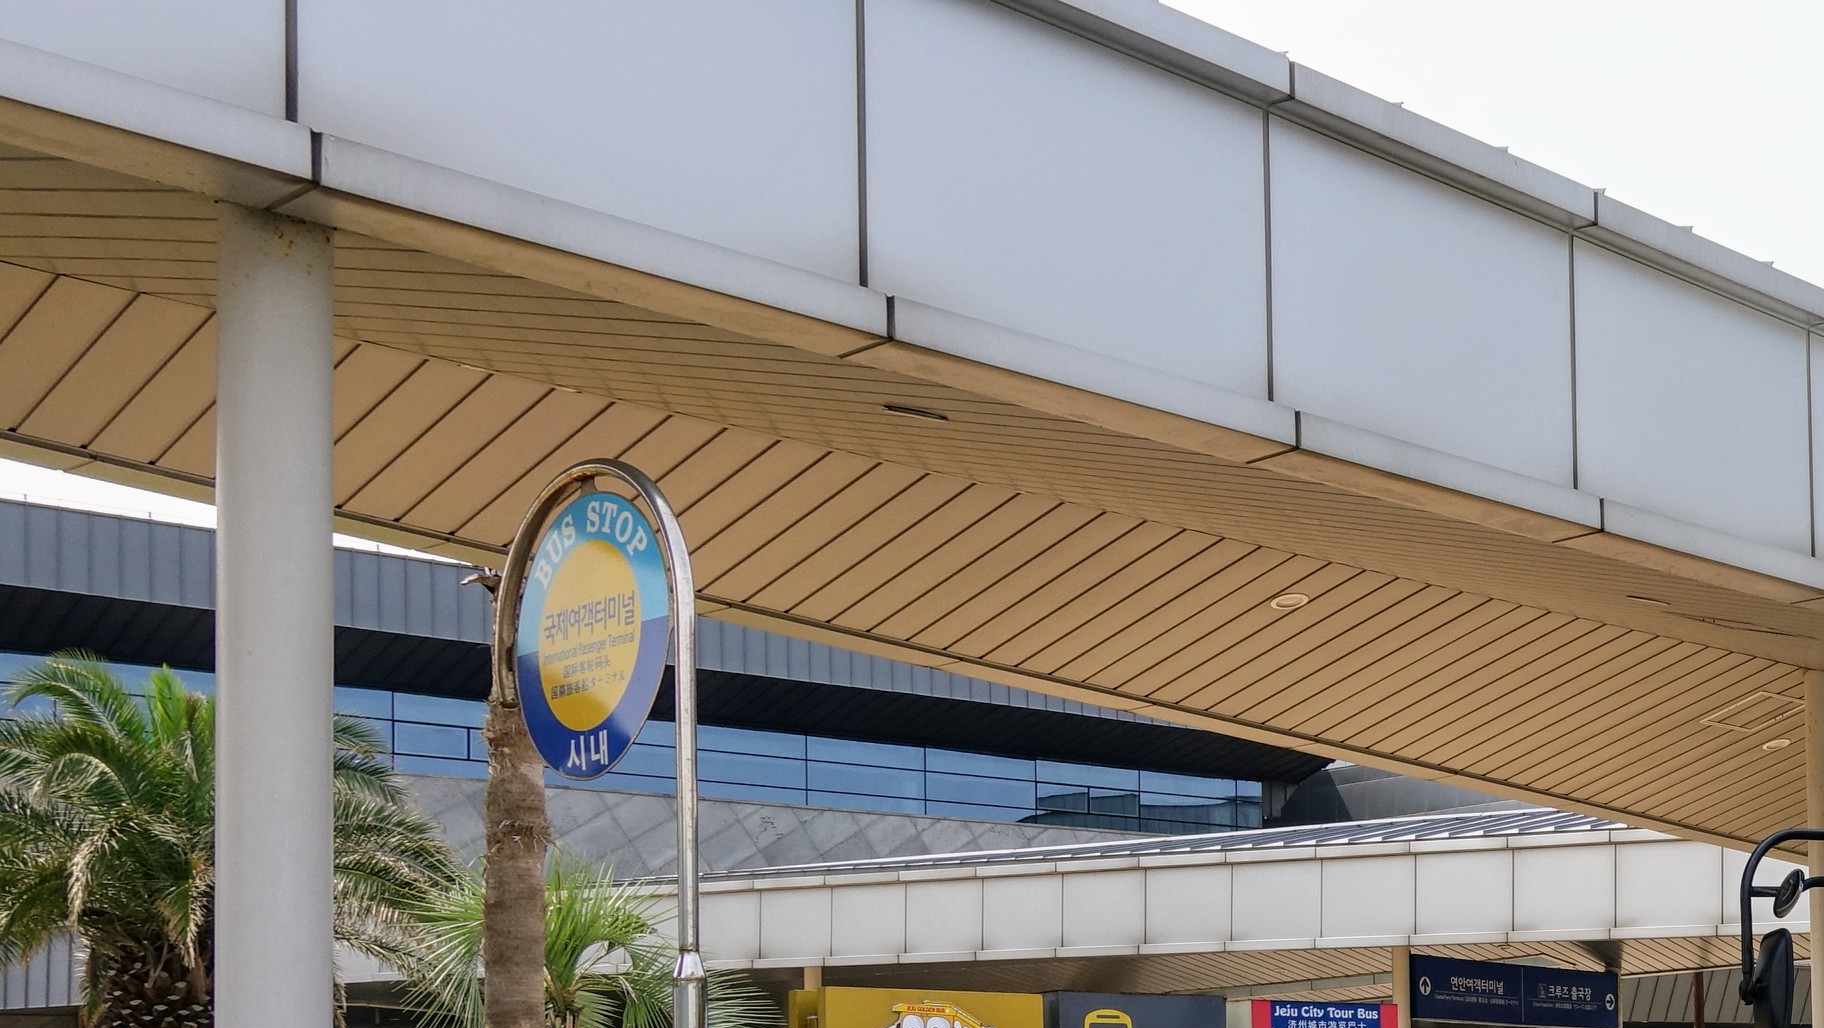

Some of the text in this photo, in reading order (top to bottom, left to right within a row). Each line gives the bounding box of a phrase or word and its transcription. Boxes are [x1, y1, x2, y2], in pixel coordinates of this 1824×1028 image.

[534, 500, 649, 592] BUS STOP
[543, 589, 635, 646] 국제여객터미널
[566, 729, 609, 771] 시내
[1450, 976, 1504, 995] 연안여객터미널
[1548, 985, 1591, 1001] 크루즈 출국장
[1274, 1004, 1379, 1019] Jeju City Tour Bus
